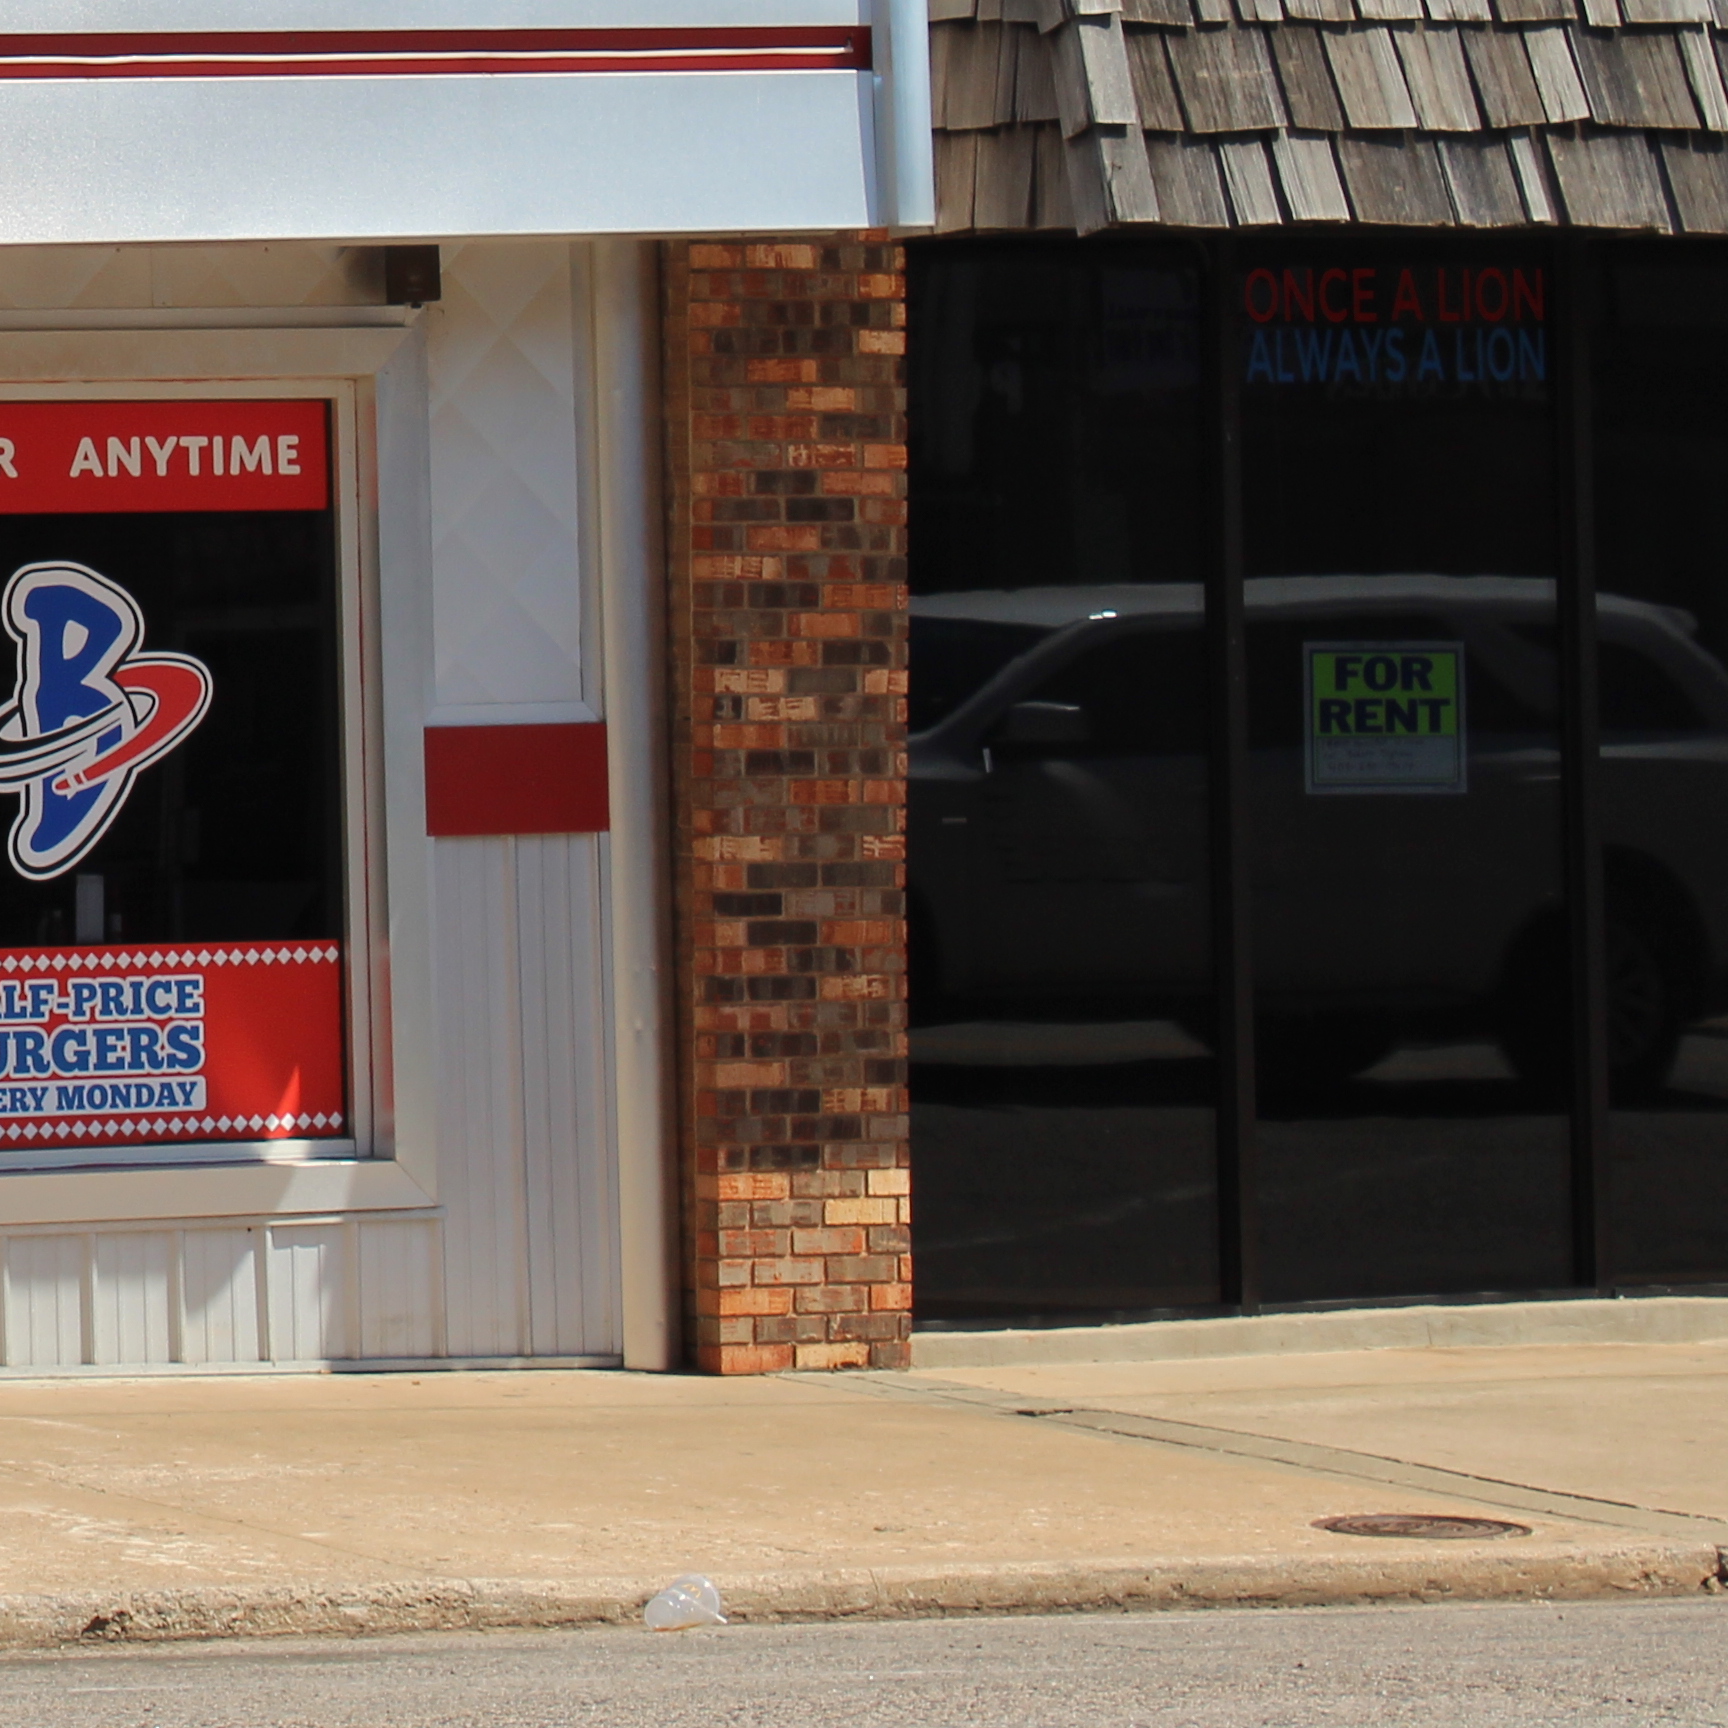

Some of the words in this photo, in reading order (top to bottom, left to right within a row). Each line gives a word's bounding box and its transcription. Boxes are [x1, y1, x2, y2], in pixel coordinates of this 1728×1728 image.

[1243, 266, 1380, 323] ONCE
[1390, 267, 1426, 322] A
[1435, 266, 1548, 322] LION
[1246, 327, 1409, 382] ALWAYS
[1416, 328, 1446, 382] A
[1455, 327, 1547, 382] LION
[69, 434, 301, 477] ANYTIME
[1334, 655, 1434, 692] FOR
[1319, 698, 1451, 734] RENT
[56, 1081, 198, 1112] MONDAY
